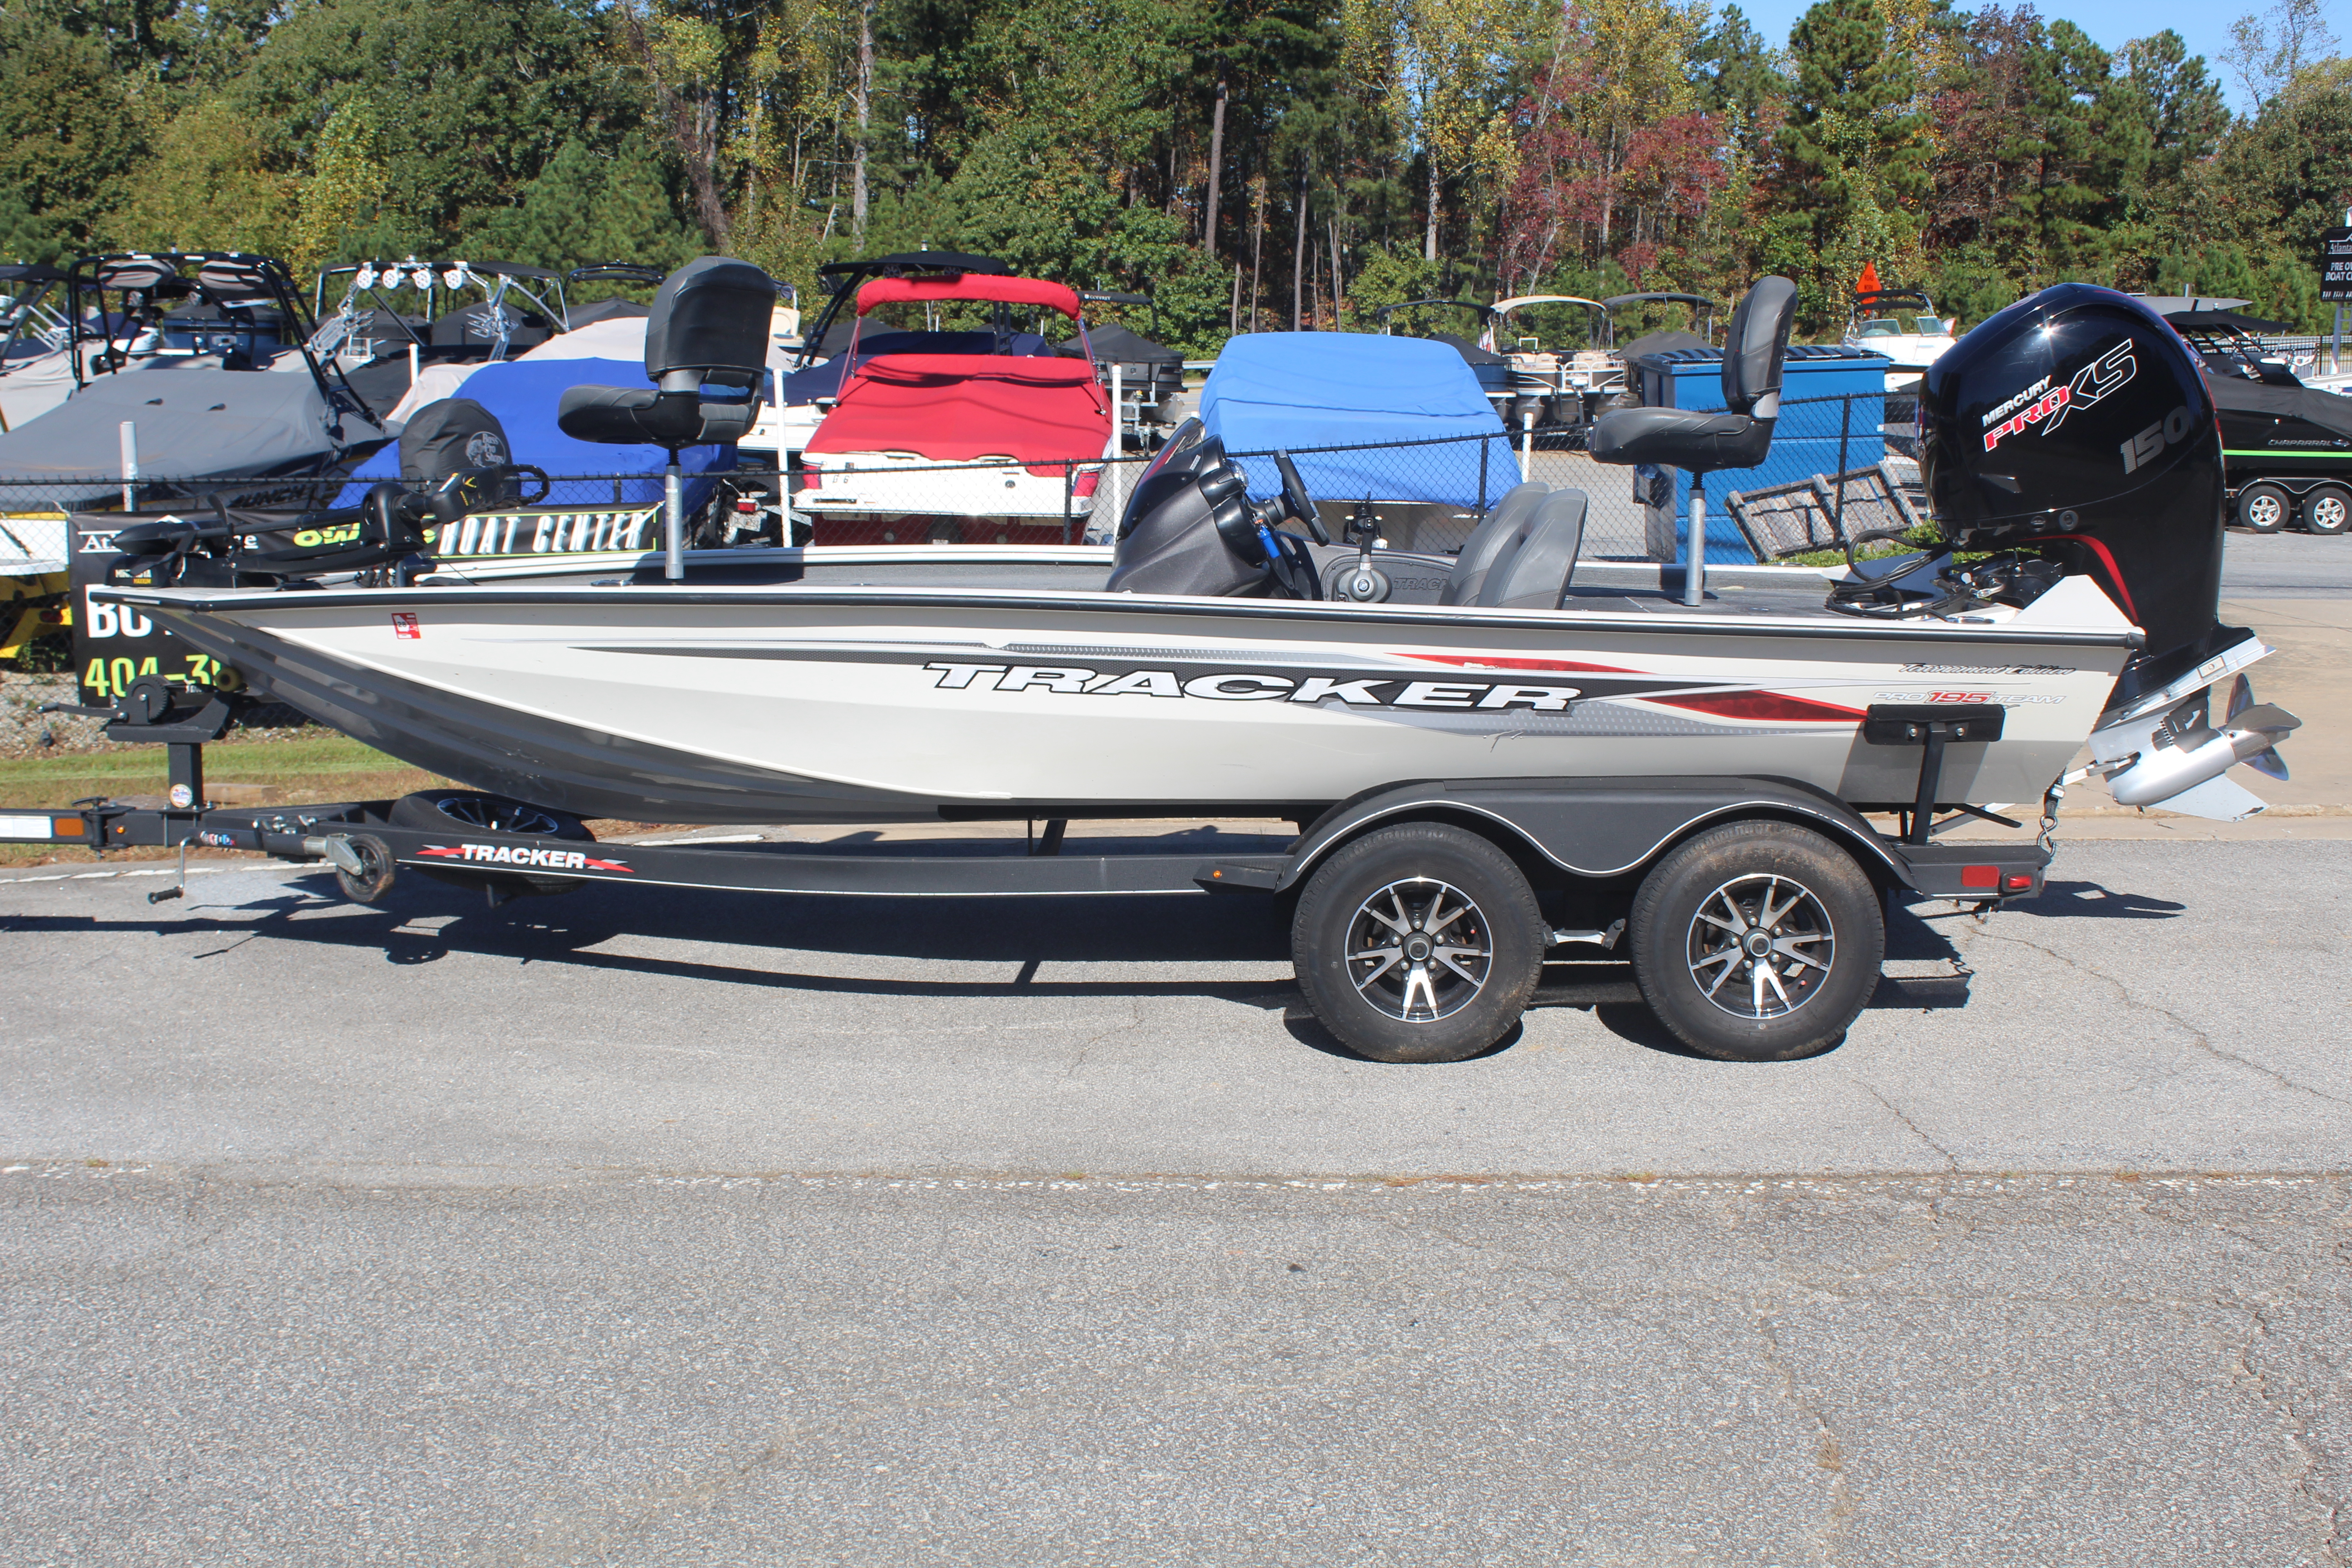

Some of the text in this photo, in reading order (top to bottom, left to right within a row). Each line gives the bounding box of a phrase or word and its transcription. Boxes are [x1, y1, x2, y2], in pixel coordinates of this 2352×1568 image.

[2331, 262, 2344, 271] PRE
[2325, 272, 2345, 281] BOAT
[1981, 375, 2052, 427] MERCURY
[1983, 338, 2137, 452] PRO XS
[482, 433, 499, 445] Bass
[2121, 406, 2190, 475] 150
[484, 443, 496, 453] Pro
[438, 516, 521, 556] BOAT
[532, 513, 644, 554] CENTER
[1394, 577, 1447, 590] TRACK
[1897, 663, 2077, 675] Tournament Edition
[922, 662, 1582, 711] TRACKER
[1874, 690, 2067, 704] PRO 195 TEAM
[461, 843, 586, 869] TRACKER
